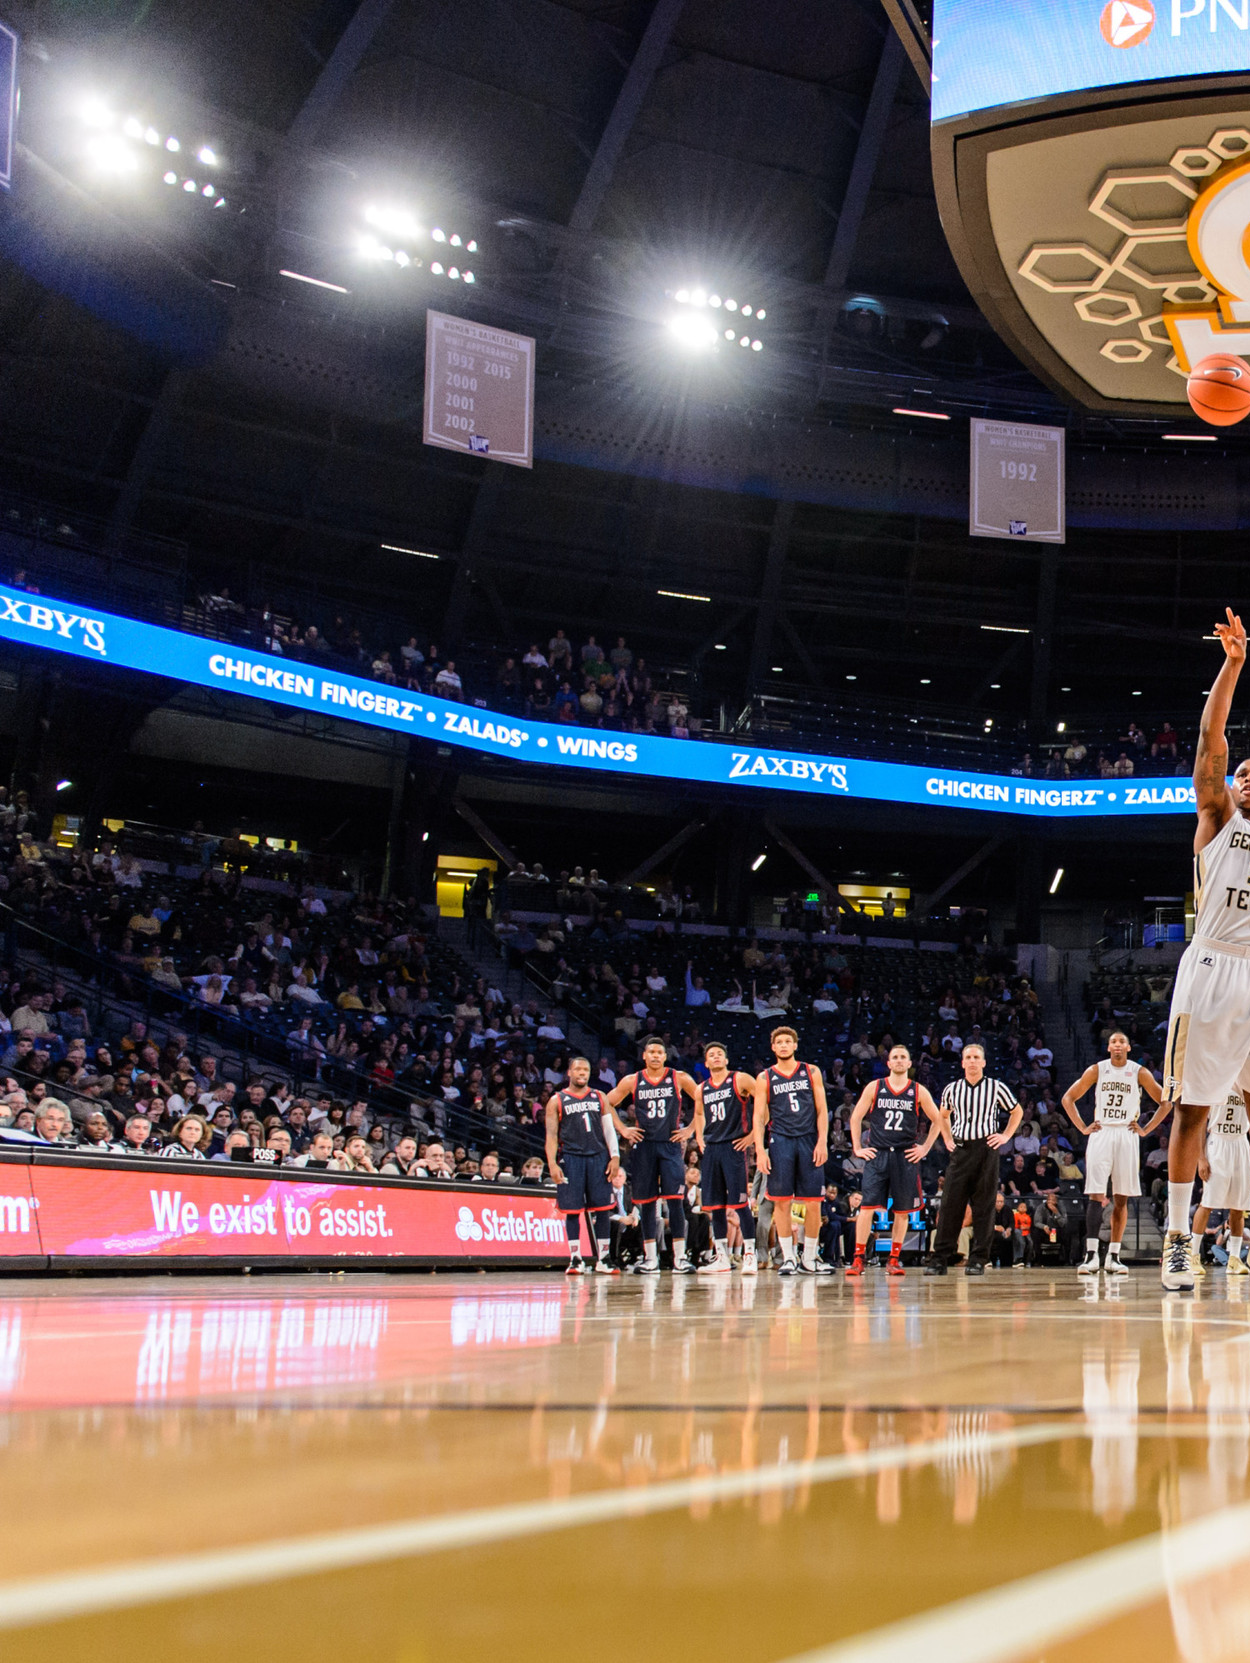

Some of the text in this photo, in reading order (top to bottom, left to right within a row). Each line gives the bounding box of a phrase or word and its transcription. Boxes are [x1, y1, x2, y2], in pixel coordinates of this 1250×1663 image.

[447, 351, 512, 380] 1992 2015
[446, 372, 478, 392] 2000
[445, 393, 475, 412] 2001
[444, 413, 475, 432] 2002
[984, 425, 1051, 439] WOMEN'S BASKETBALL
[1000, 460, 1038, 482] 1992
[208, 654, 314, 697] CHICKEN
[556, 735, 638, 762] WINGS
[728, 752, 849, 792] ZAXBY'S
[926, 777, 1010, 802] CHICKEN
[773, 1080, 809, 1095] DUQUESNE
[1101, 1082, 1132, 1094] GEORGIA
[1165, 1076, 1180, 1090] GT
[638, 1087, 673, 1100] DUQUESNE
[704, 1088, 732, 1105] DUQUESNE
[789, 1093, 800, 1112] 5
[1106, 1094, 1124, 1107] 33
[564, 1101, 600, 1115] DUQUESNE
[647, 1099, 666, 1119] 33
[877, 1098, 913, 1111] DUQUESNE
[582, 1112, 591, 1132] 1
[884, 1110, 904, 1131] 22
[1103, 1109, 1127, 1119] TECH
[1226, 1108, 1234, 1121] 2
[1217, 1123, 1242, 1134] TECH
[253, 1148, 276, 1160] POSS
[150, 1190, 394, 1238] We exist to assist.
